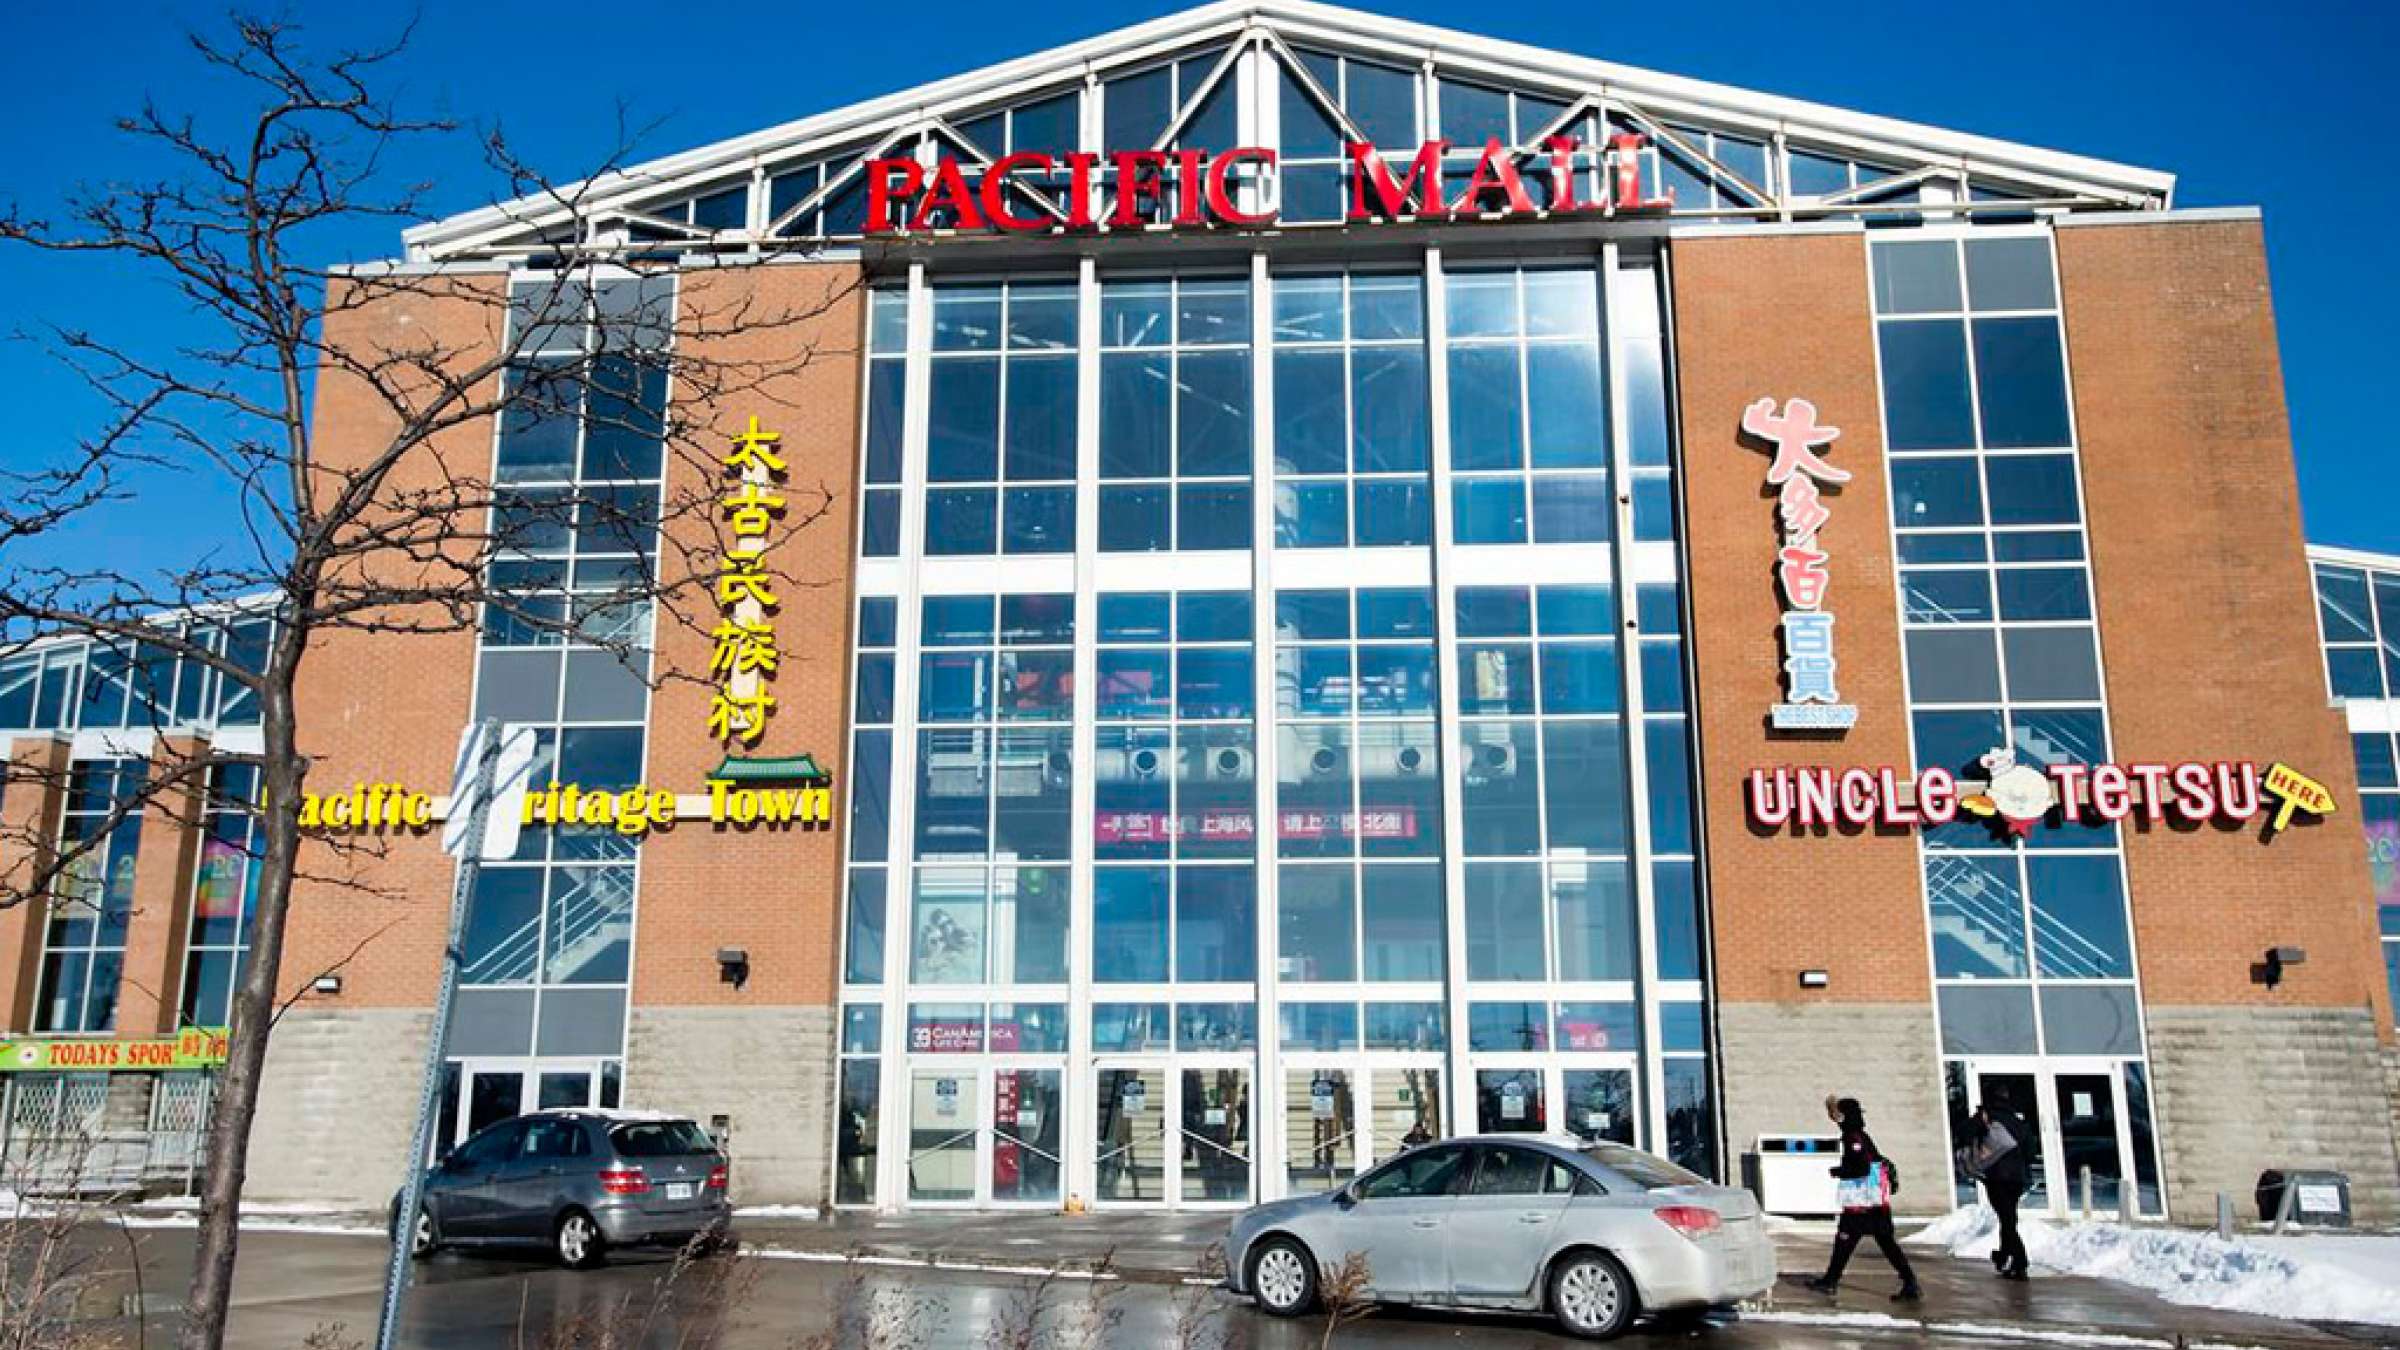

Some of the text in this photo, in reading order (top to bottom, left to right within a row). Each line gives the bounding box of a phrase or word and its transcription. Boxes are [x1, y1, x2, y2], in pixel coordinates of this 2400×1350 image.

[864, 136, 1675, 233] PACIFIC MALL
[708, 415, 789, 741] 太古民族村
[261, 779, 831, 834] acific ritage Town
[2270, 768, 2326, 808] HERE
[51, 1043, 119, 1065] TODAYS
